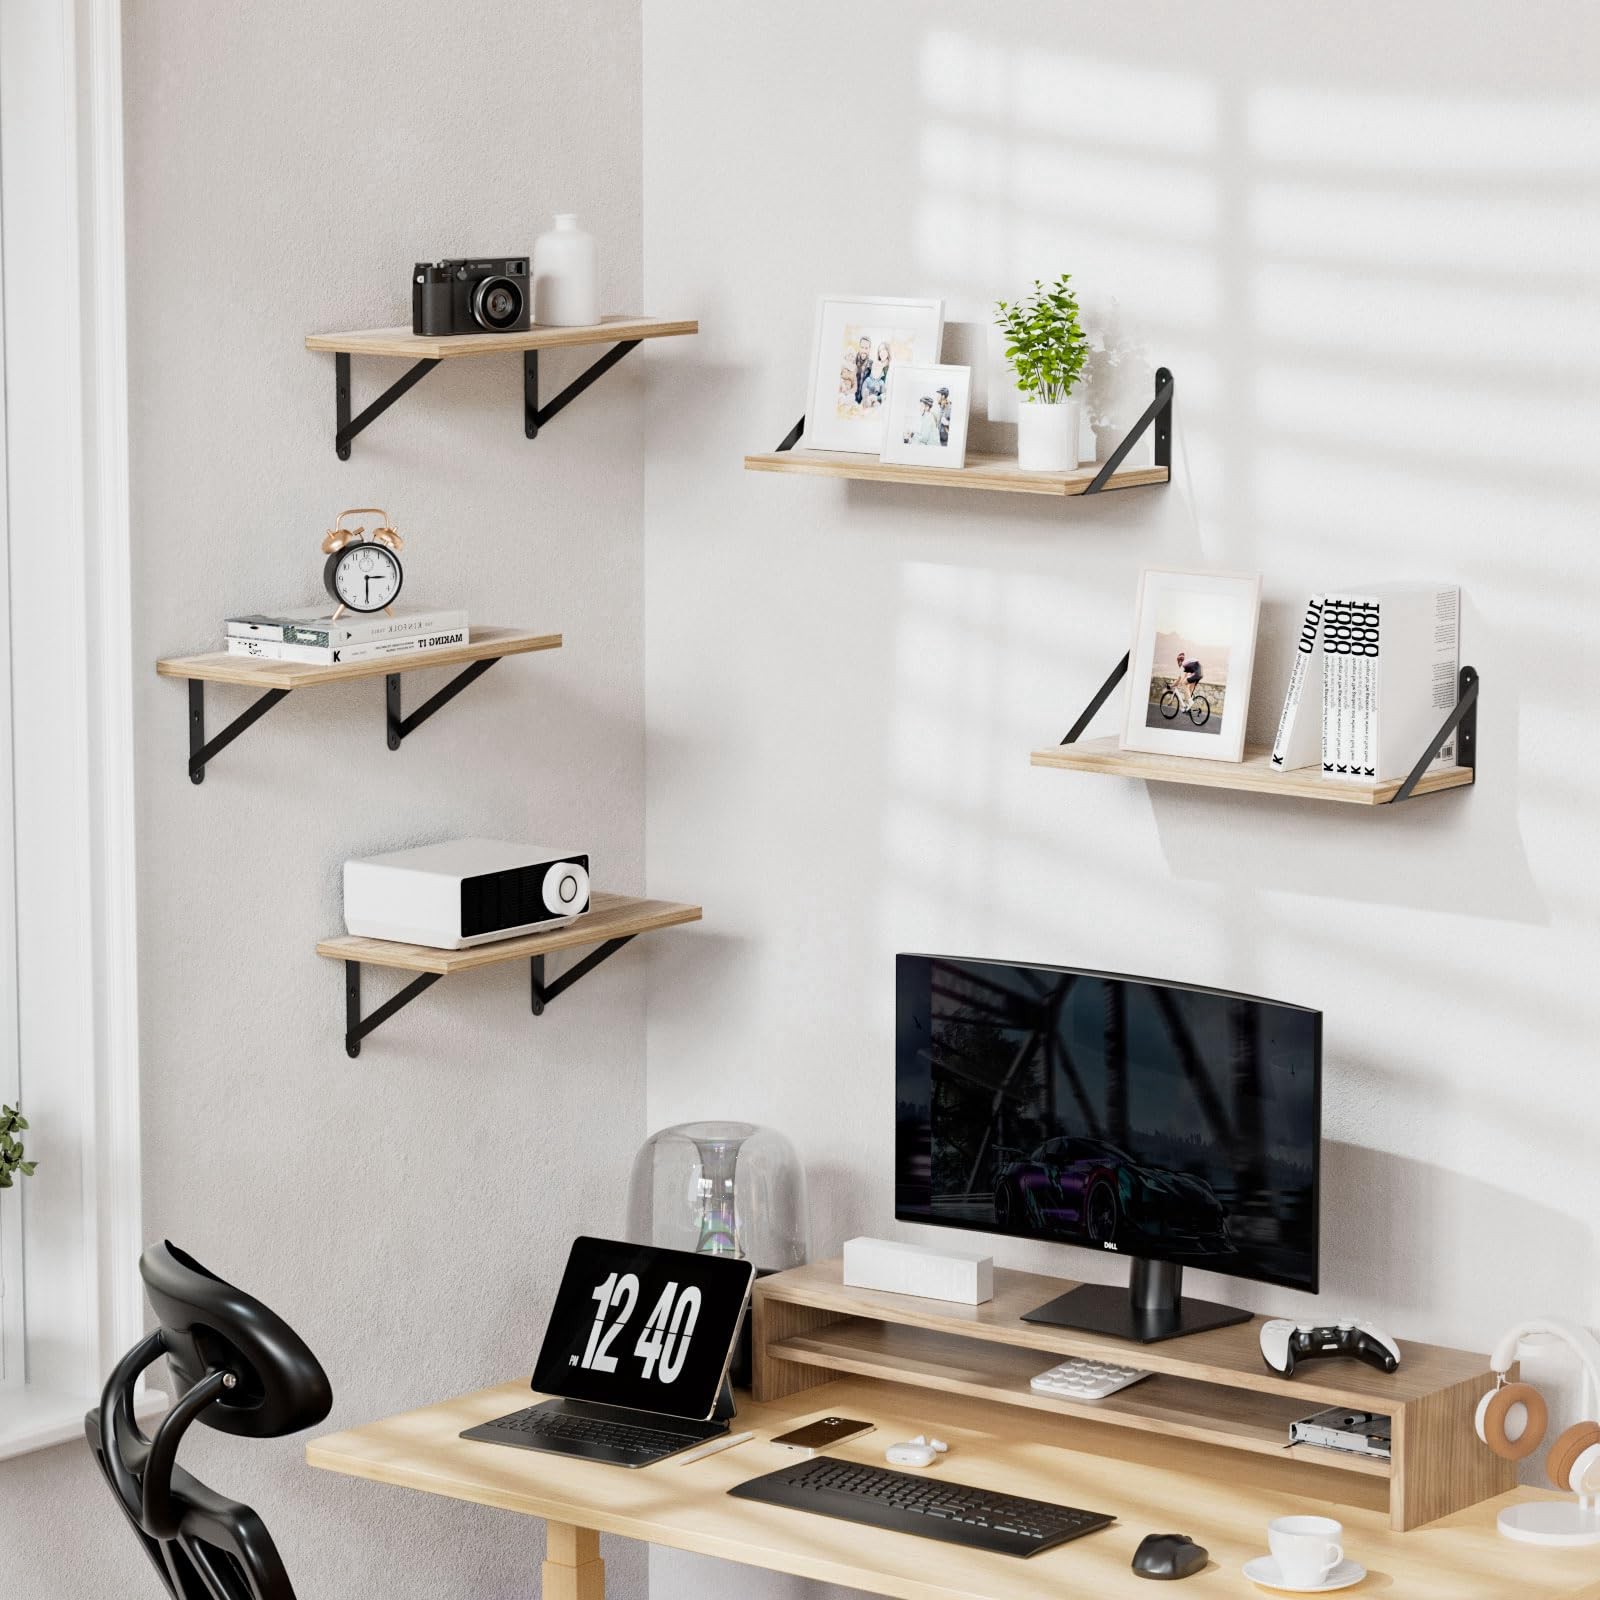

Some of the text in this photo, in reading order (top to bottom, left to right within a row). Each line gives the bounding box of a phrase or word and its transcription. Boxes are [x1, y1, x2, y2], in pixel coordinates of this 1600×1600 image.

[332, 650, 341, 663] K
[1272, 754, 1283, 765] K
[1324, 763, 1334, 771] K
[1337, 764, 1347, 773] K
[1351, 766, 1361, 775] K
[1365, 767, 1375, 776] K
[1104, 1241, 1118, 1251] DELL
[569, 1272, 702, 1384] PM 12 40
